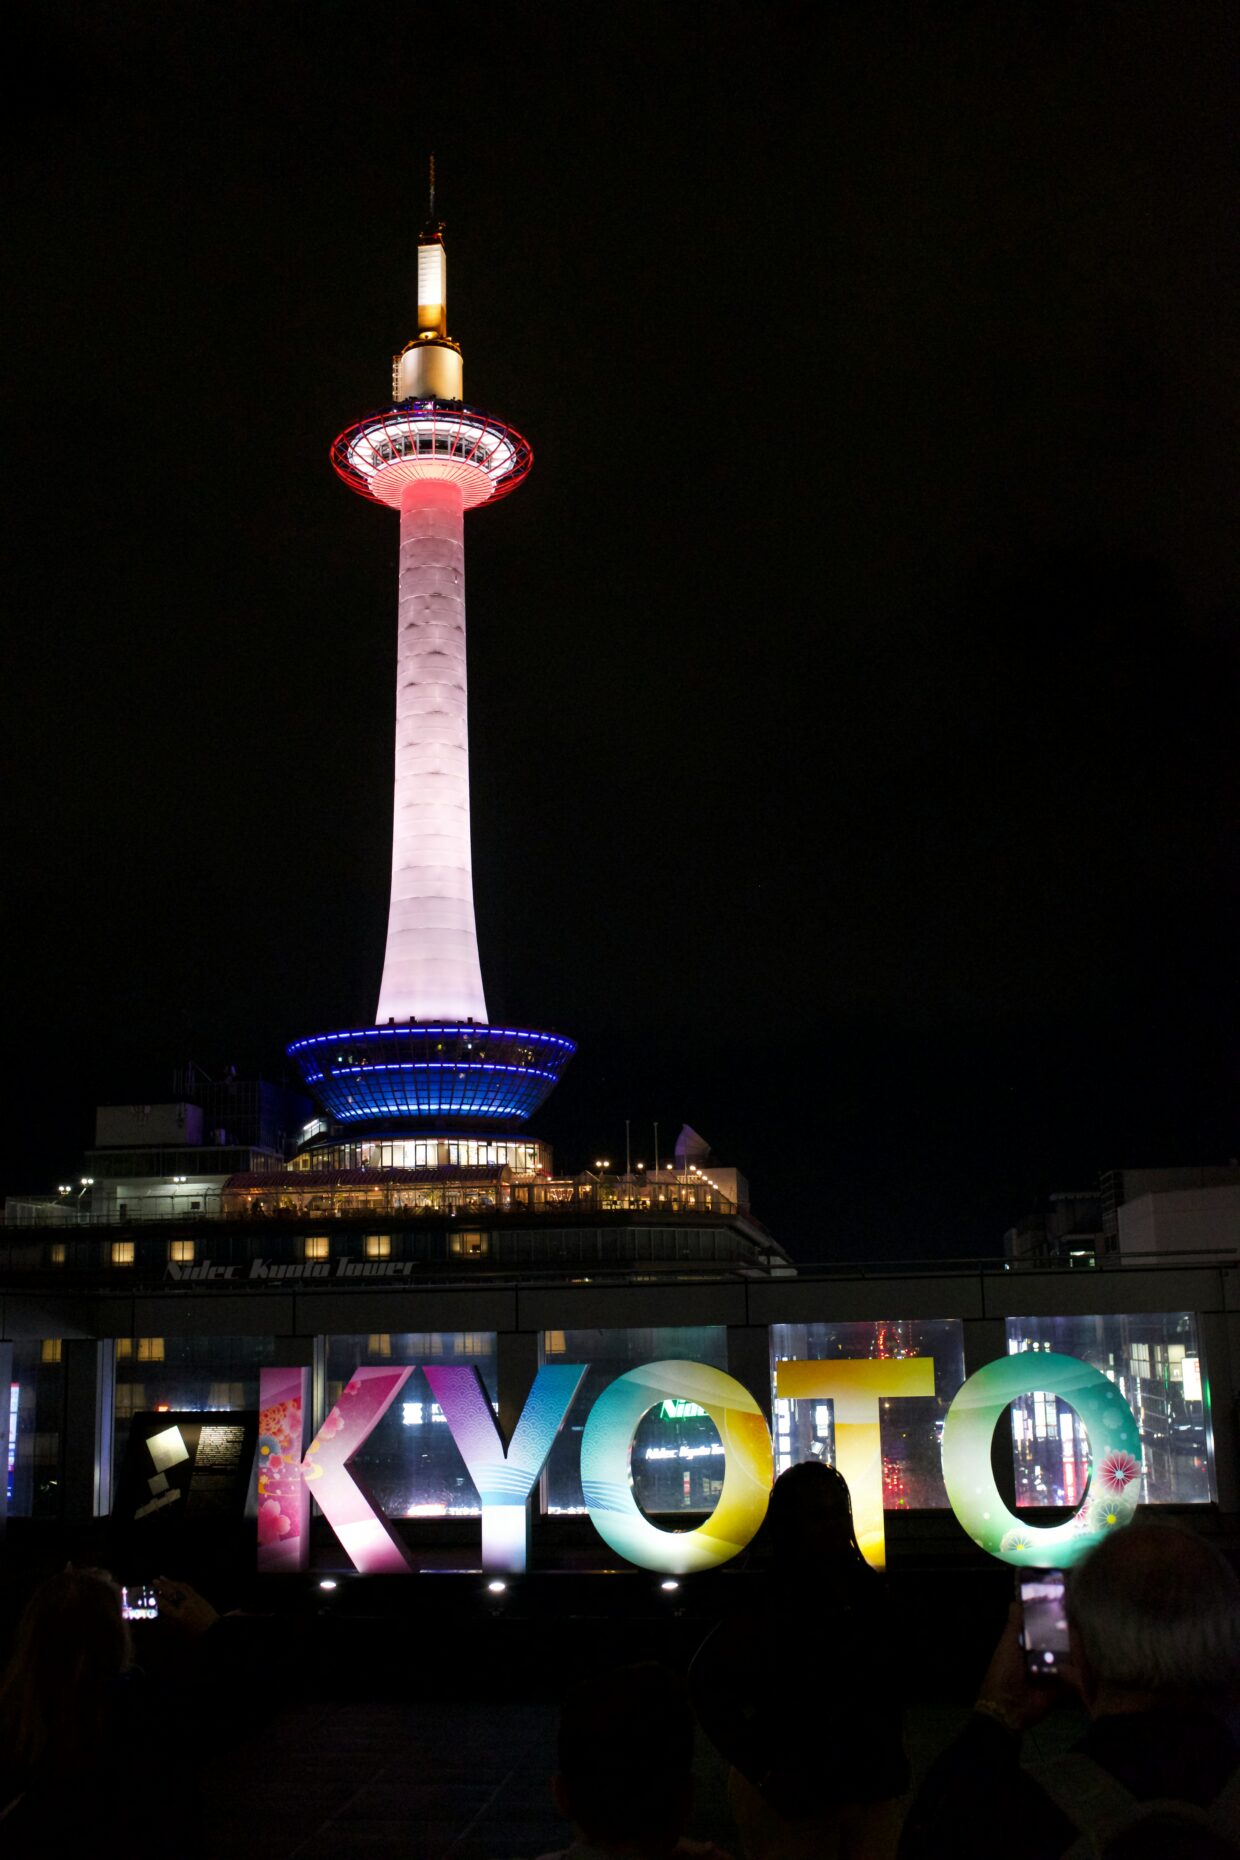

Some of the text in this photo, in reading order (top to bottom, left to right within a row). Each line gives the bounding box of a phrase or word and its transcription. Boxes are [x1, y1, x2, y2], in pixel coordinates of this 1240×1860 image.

[163, 1256, 421, 1285] Nidec Kyoto Tower
[258, 1351, 1142, 1574] KYOTO
